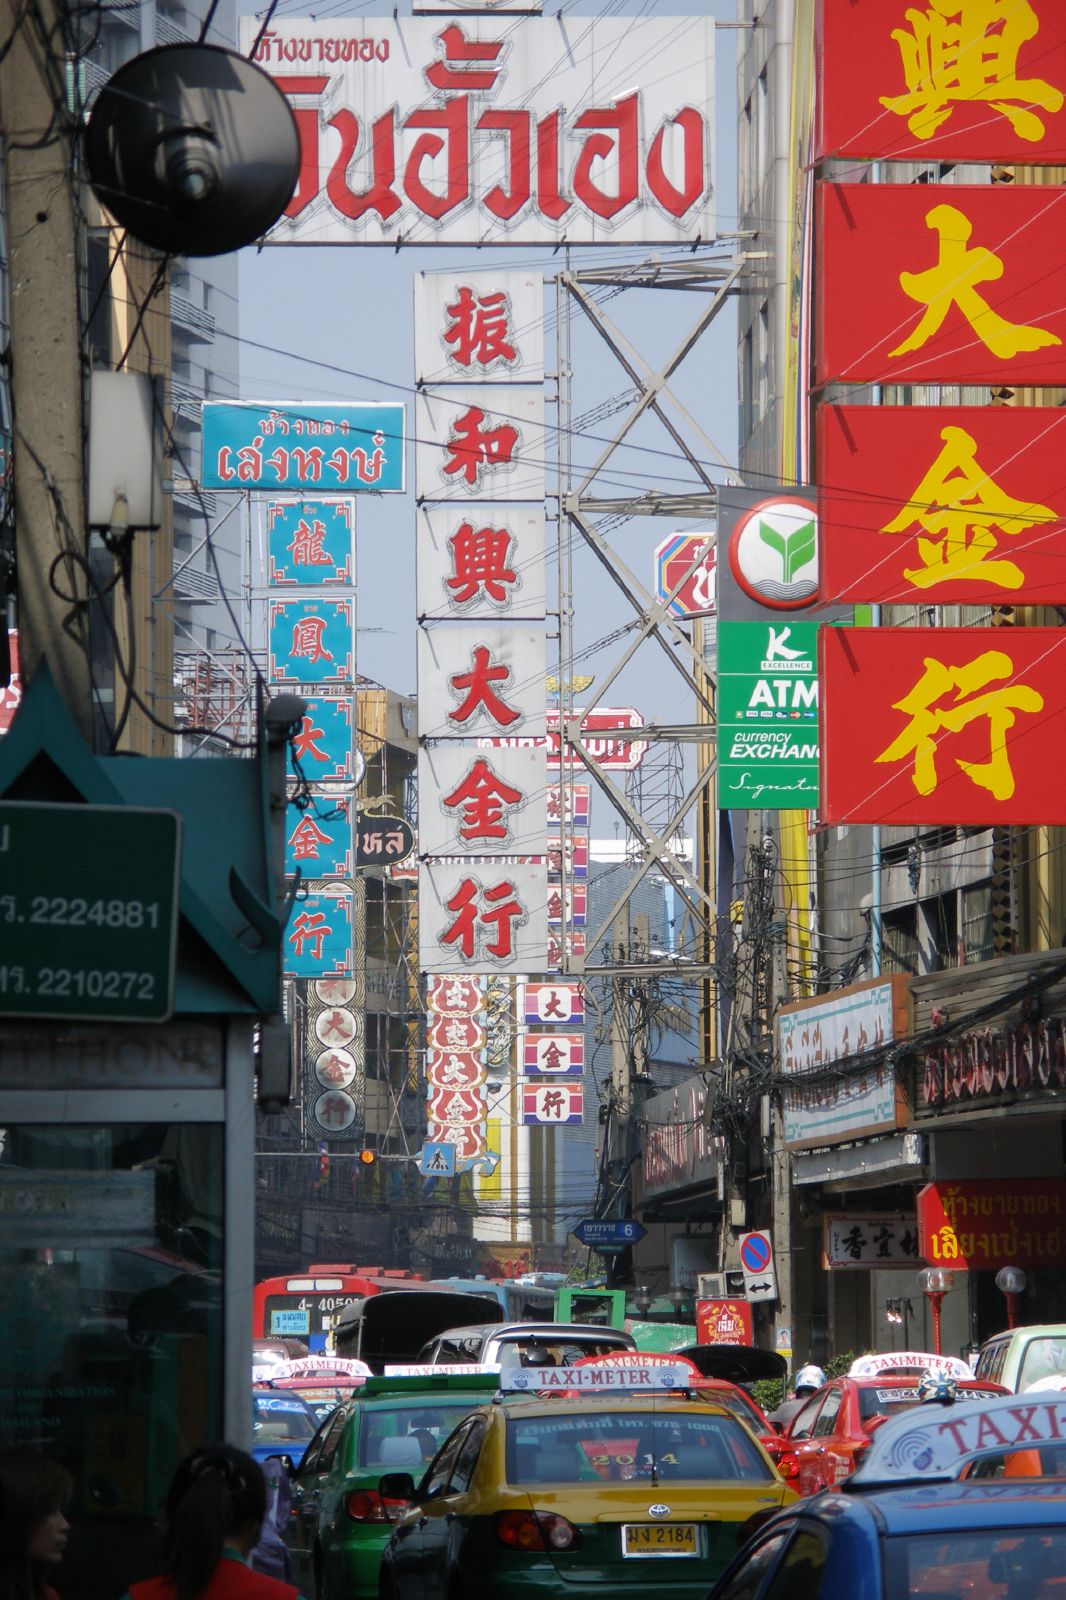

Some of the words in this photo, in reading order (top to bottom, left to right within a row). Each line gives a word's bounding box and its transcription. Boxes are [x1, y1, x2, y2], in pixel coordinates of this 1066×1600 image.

[258, 410, 349, 436] ห้างทอง
[766, 626, 808, 662] K
[762, 662, 812, 670] EXCELLENCE
[748, 680, 819, 708] ATM
[734, 732, 792, 743] currency
[30, 897, 158, 928] 2224881
[37, 968, 155, 1000] 2210272
[624, 1224, 633, 1237] 6
[870, 1355, 954, 1371] TAXI-METER
[537, 1370, 652, 1386] TAXI-METER
[591, 1453, 681, 1466] 2014
[656, 1528, 693, 1543] 2184
